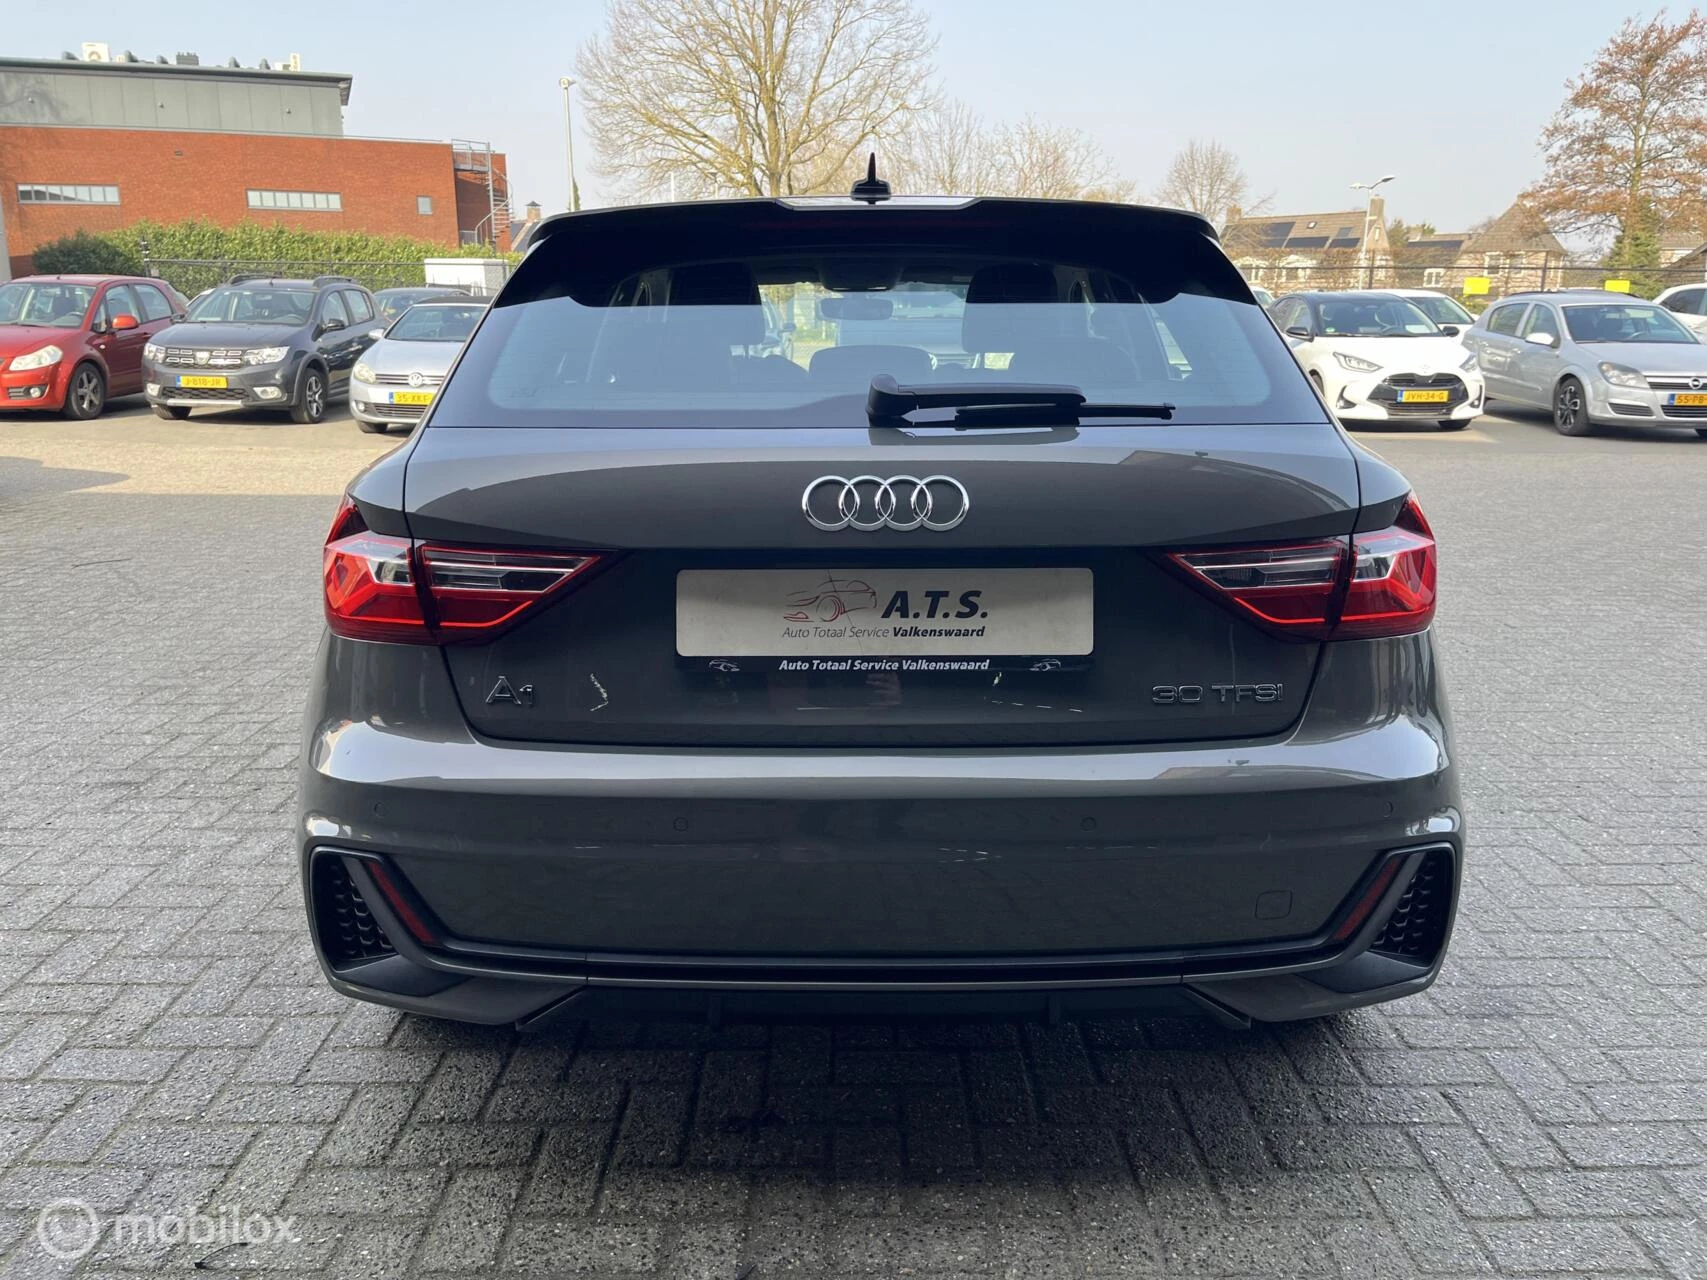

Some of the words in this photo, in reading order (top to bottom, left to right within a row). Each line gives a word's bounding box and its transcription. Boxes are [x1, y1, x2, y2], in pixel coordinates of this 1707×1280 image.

[881, 590, 989, 619] A.T.S.
[782, 626, 810, 638] Auto
[812, 626, 848, 638] Totaal
[849, 626, 890, 638] Service
[892, 626, 986, 638] Valkenswaard
[779, 660, 810, 671] Auto
[811, 659, 851, 671] Totaal
[852, 659, 899, 671] Service
[902, 659, 990, 671] Valkenswaard
[485, 675, 534, 705] A1
[1152, 685, 1203, 703] 30
[1211, 684, 1283, 702] TFSI
